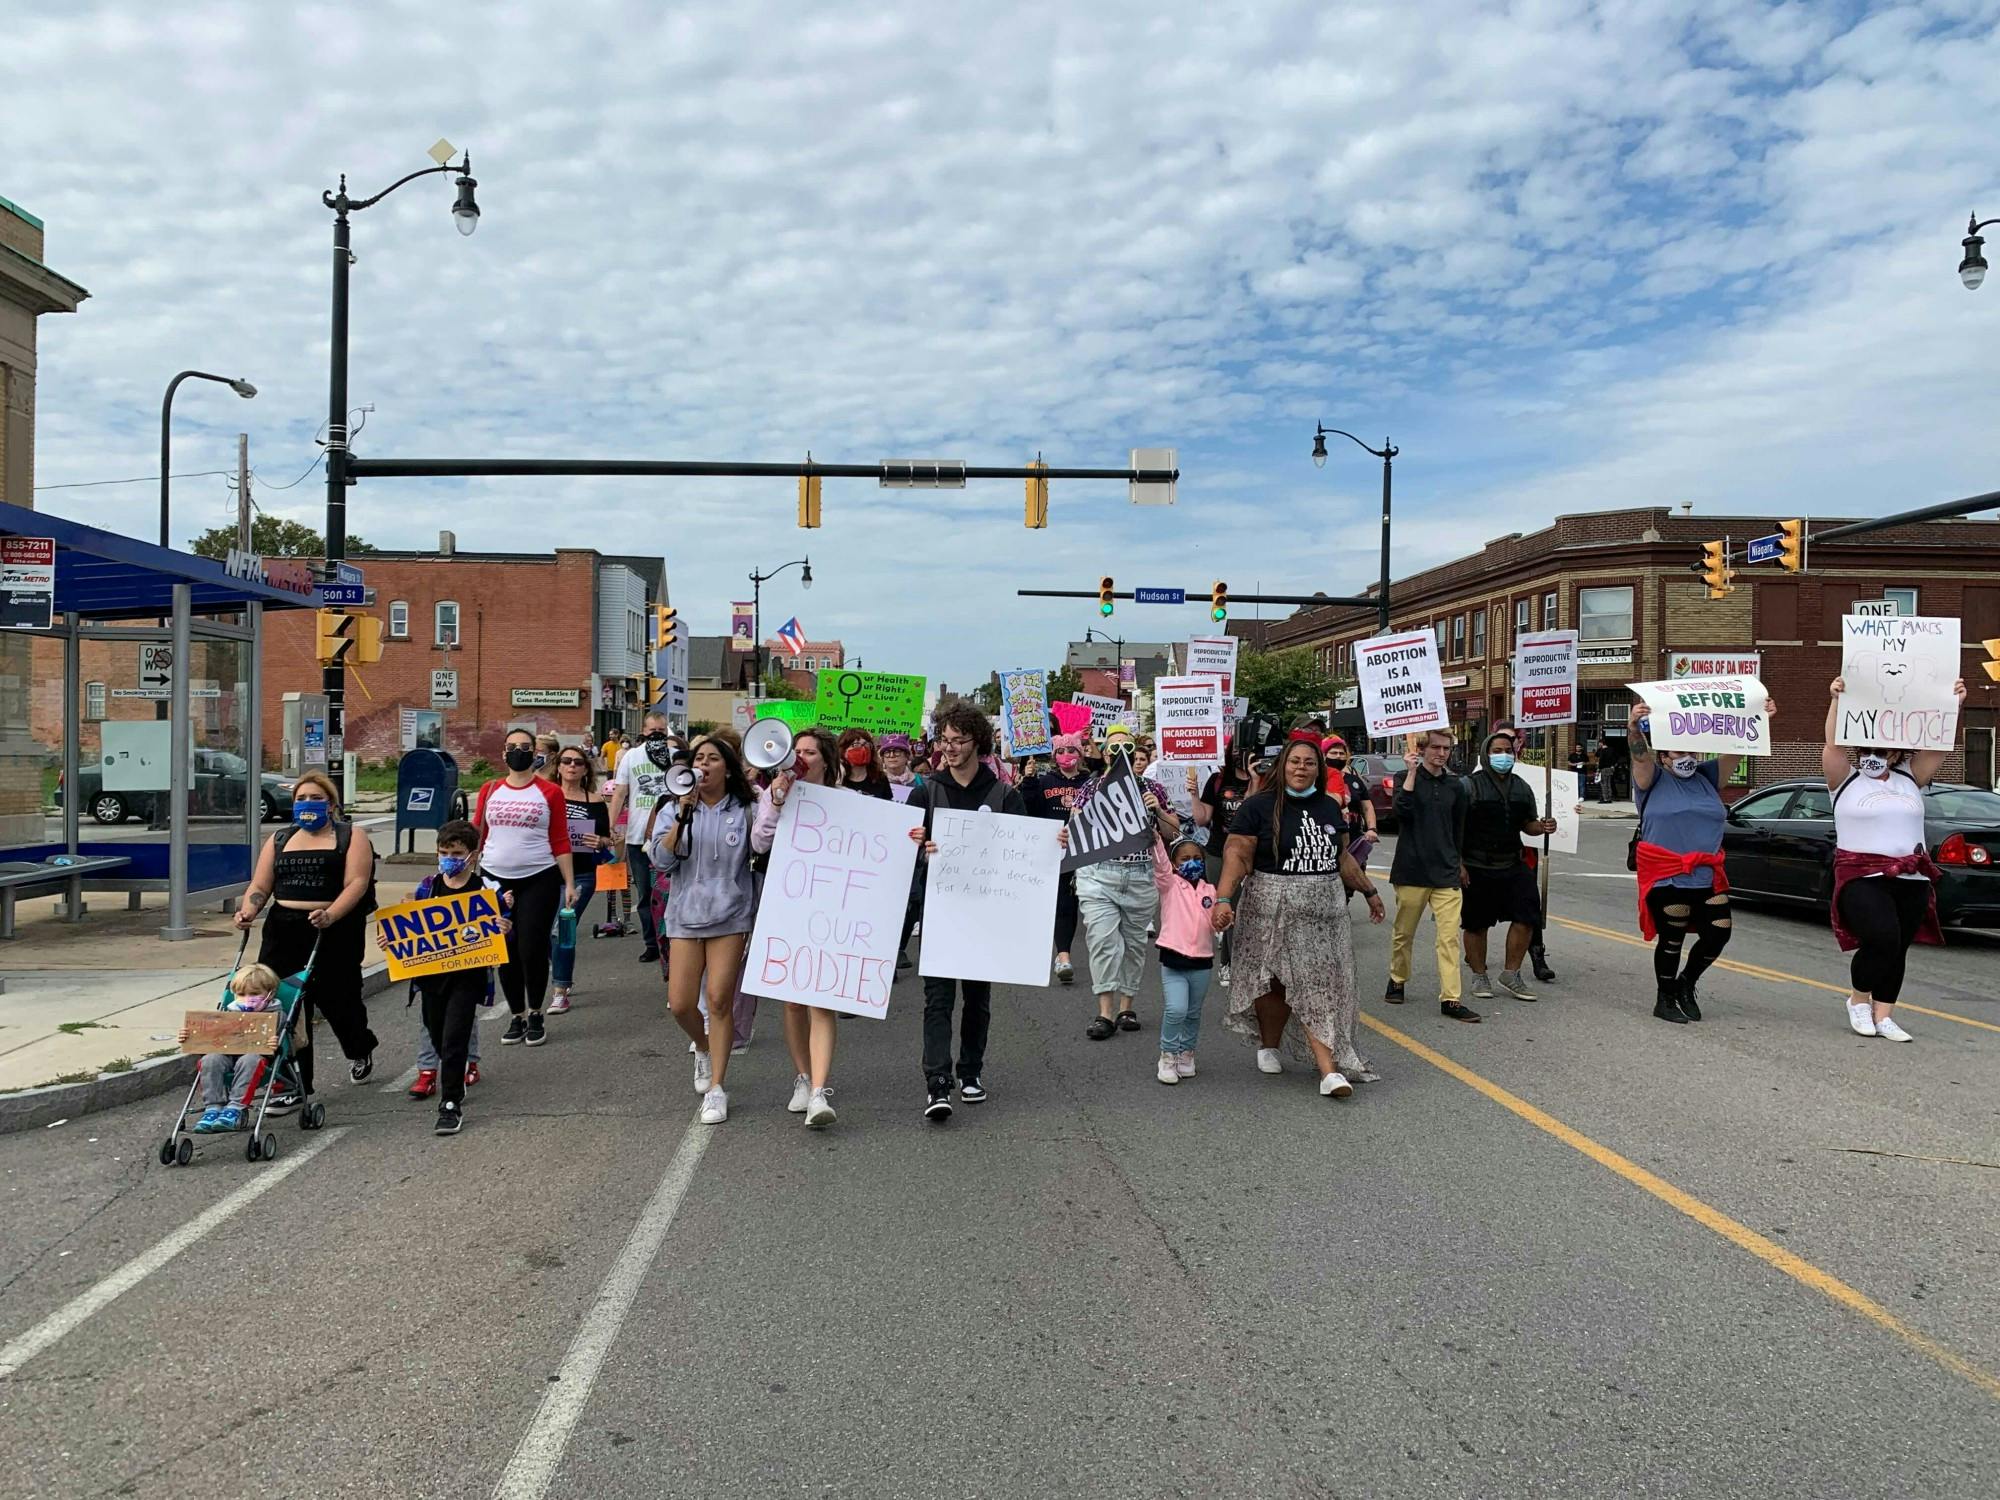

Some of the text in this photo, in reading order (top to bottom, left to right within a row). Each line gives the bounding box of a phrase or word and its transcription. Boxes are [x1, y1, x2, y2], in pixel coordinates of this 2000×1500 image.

[6, 541, 48, 550] 855-7211
[1752, 544, 1773, 558] Niagara
[322, 590, 355, 600] son St
[1140, 591, 1169, 600] Hudson
[1860, 604, 1892, 616] ONE
[1846, 619, 1943, 637] WHAT MAKES
[1883, 638, 1906, 652] MY
[1367, 646, 1427, 667] ABORTION
[1524, 653, 1570, 664] REPRODUCTIVE
[1388, 666, 1410, 679] IS A
[1528, 668, 1553, 676] JUSTICE
[1691, 660, 1757, 674] KINGS OF DA WEST
[877, 676, 909, 684] Health
[875, 684, 905, 693] Rights
[1380, 682, 1422, 698] HUMAN
[1524, 687, 1570, 698] INCARCERATED
[875, 693, 899, 701] Lives
[1162, 696, 1213, 705] REPRODUCTIVE
[1536, 698, 1560, 708] PEOPLE
[1676, 693, 1745, 708] BEFORE
[1076, 695, 1123, 713] MANDATORY
[1384, 698, 1423, 714] RIGHT!
[820, 714, 843, 722] Don't
[876, 717, 897, 726] with
[1163, 729, 1216, 737] INCARCERATED
[1844, 709, 1957, 748] MY CHOICE
[1176, 739, 1204, 747] PEOPLE
[1303, 810, 1308, 818] P
[490, 819, 536, 829] BLEEDING
[944, 817, 976, 839] IF
[791, 800, 888, 863] Bans
[1300, 826, 1322, 836] TECT
[1296, 834, 1332, 848] BLACK
[940, 843, 970, 857] GOT
[980, 848, 988, 858] A
[1291, 845, 1338, 861] WOMEN
[938, 863, 960, 876] You
[1282, 859, 1337, 872] AT ALL COSTS
[784, 859, 880, 910] OFF
[936, 882, 954, 895] For
[963, 883, 972, 893] A
[381, 894, 496, 942] INDIA
[808, 911, 872, 948] OUR
[387, 918, 500, 960] WALTON
[403, 940, 492, 968] DEMOCRATIC NOMINEE
[441, 954, 500, 970] FOR MAYOR
[761, 937, 894, 1007] BODIES
